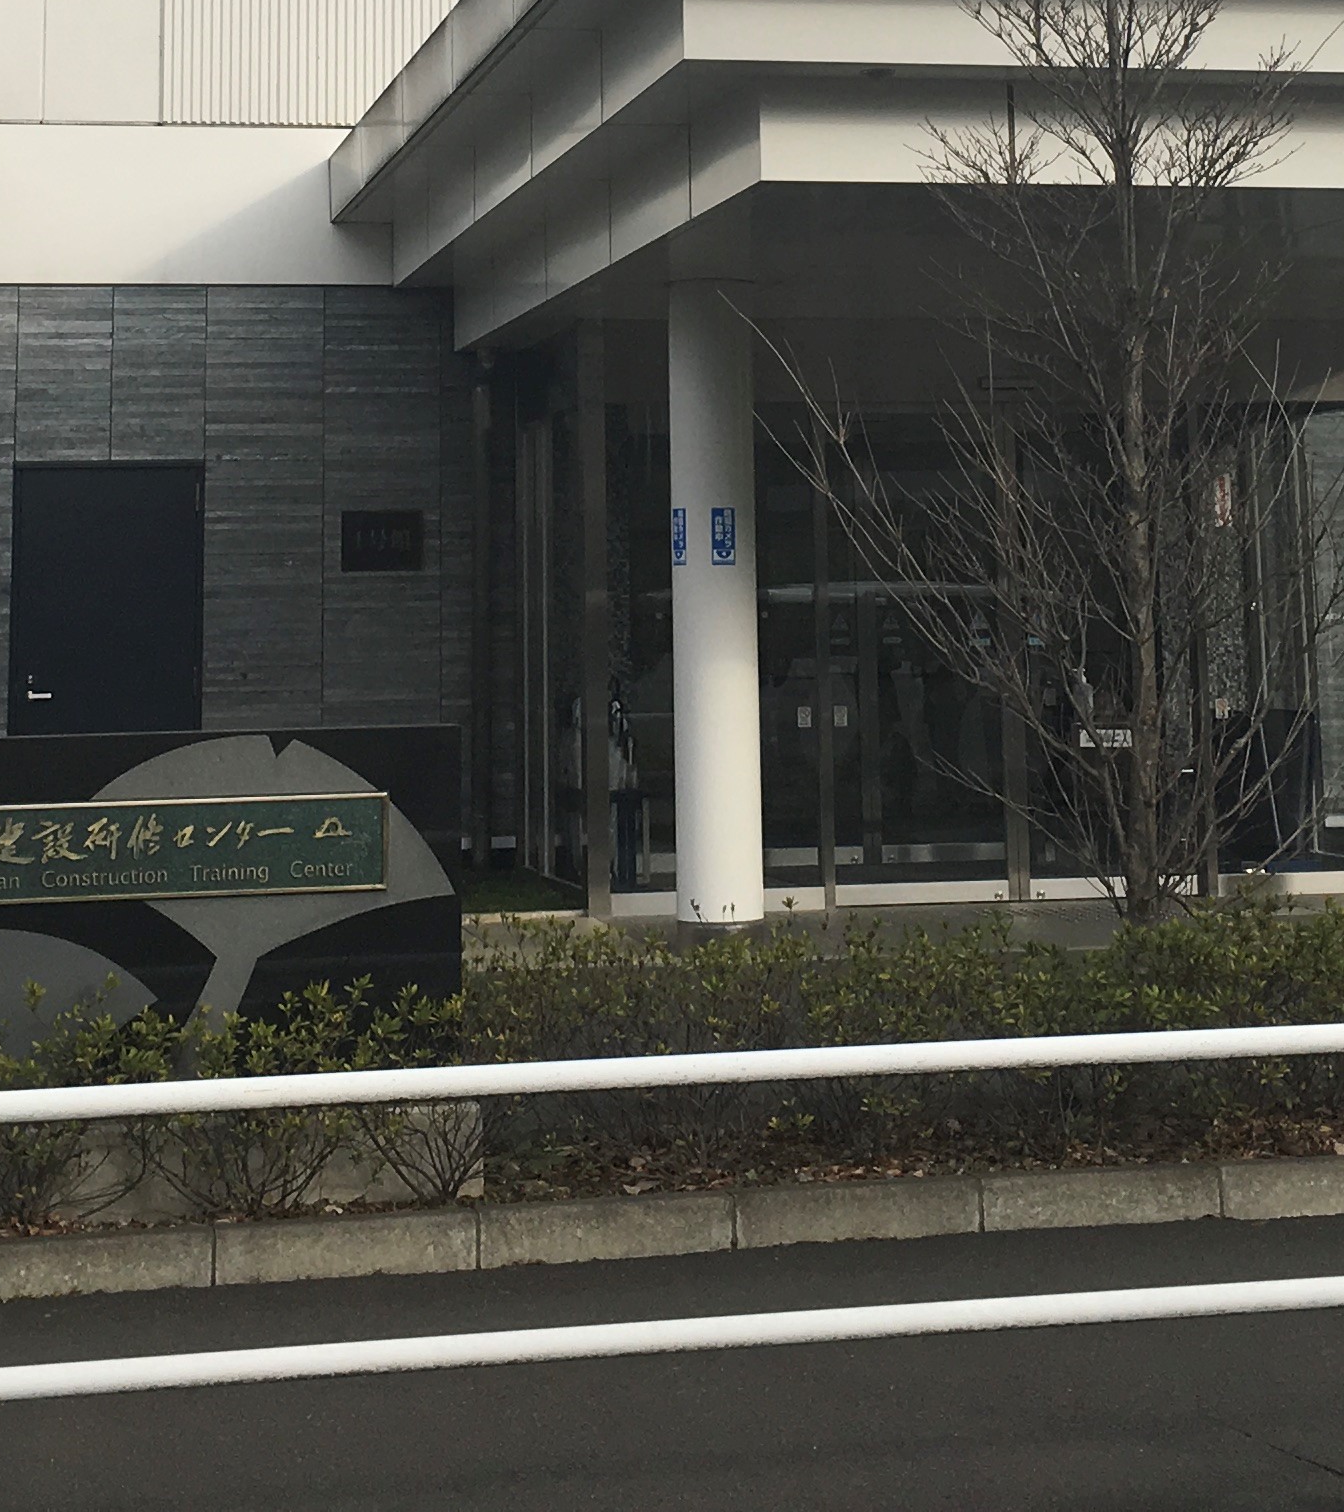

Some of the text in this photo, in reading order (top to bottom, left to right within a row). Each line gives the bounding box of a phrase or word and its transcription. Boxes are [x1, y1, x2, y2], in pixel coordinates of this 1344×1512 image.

[41, 867, 168, 888] Construction
[189, 863, 269, 883] Training
[290, 860, 354, 879] Center
